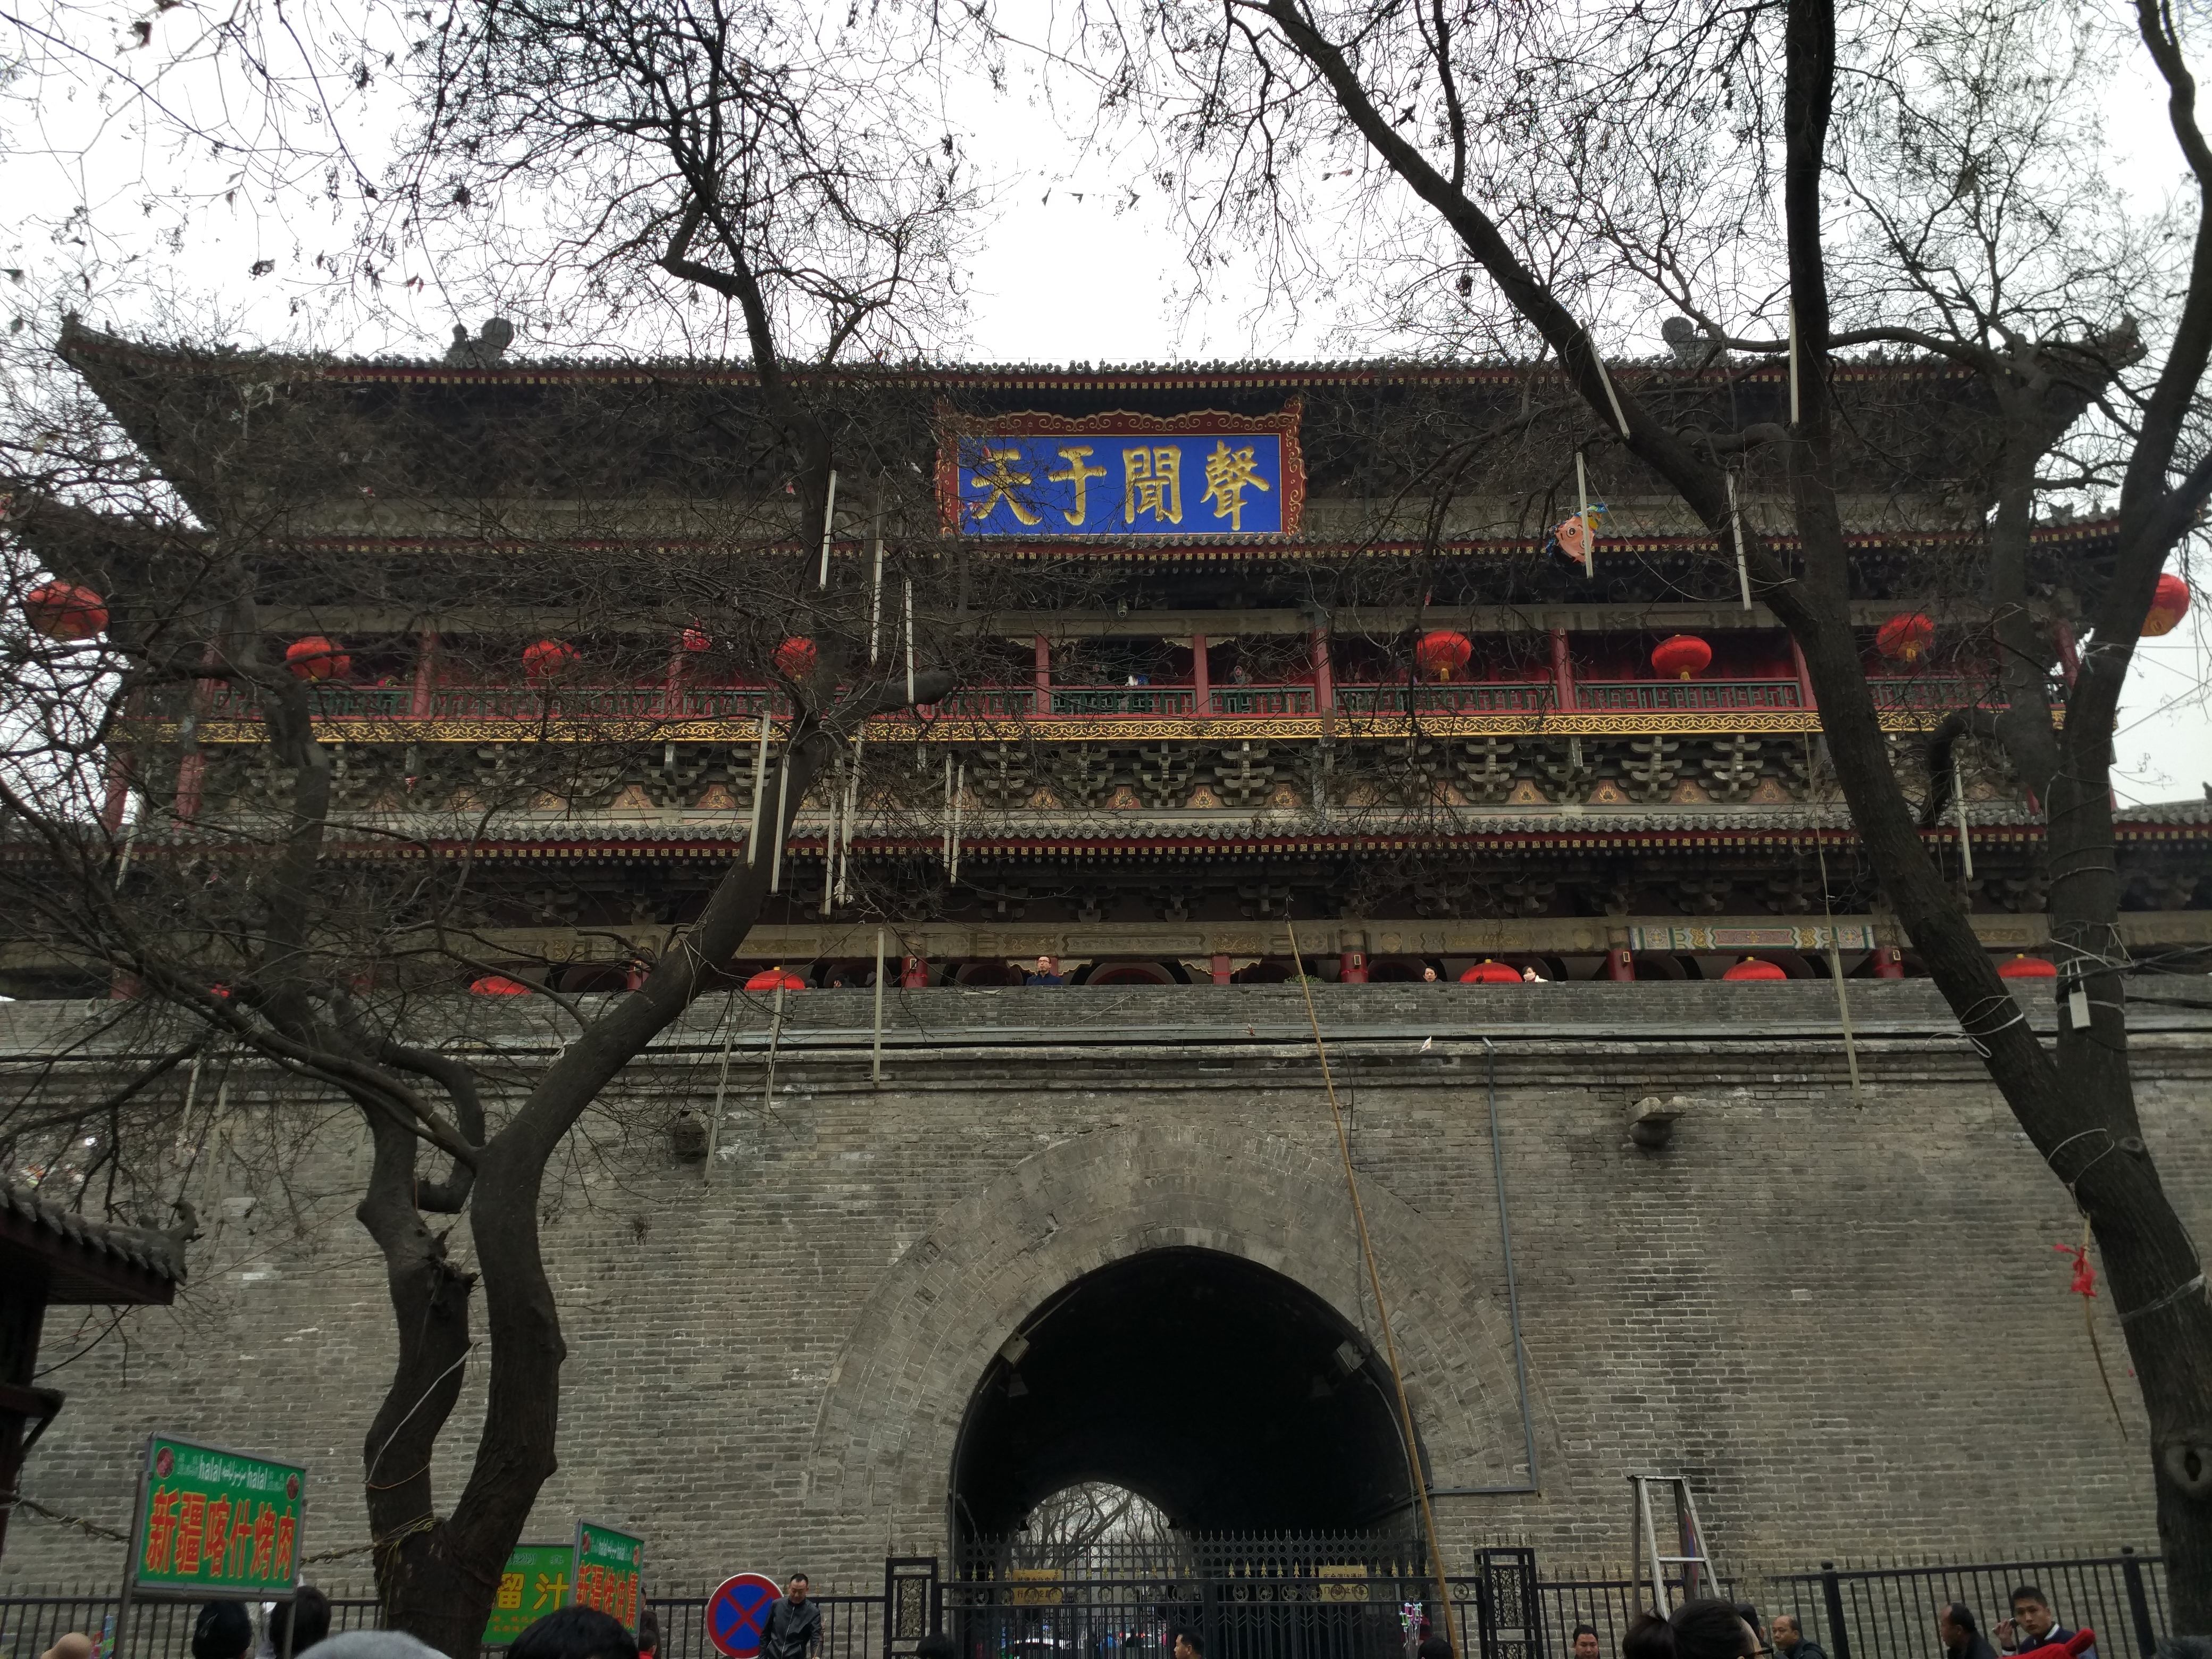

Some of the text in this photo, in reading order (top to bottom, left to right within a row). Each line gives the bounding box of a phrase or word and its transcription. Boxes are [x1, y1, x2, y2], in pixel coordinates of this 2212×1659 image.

[198, 1454, 223, 1482] halal
[247, 1464, 268, 1490] halal
[145, 1485, 296, 1581] 新疆喀什烤肉
